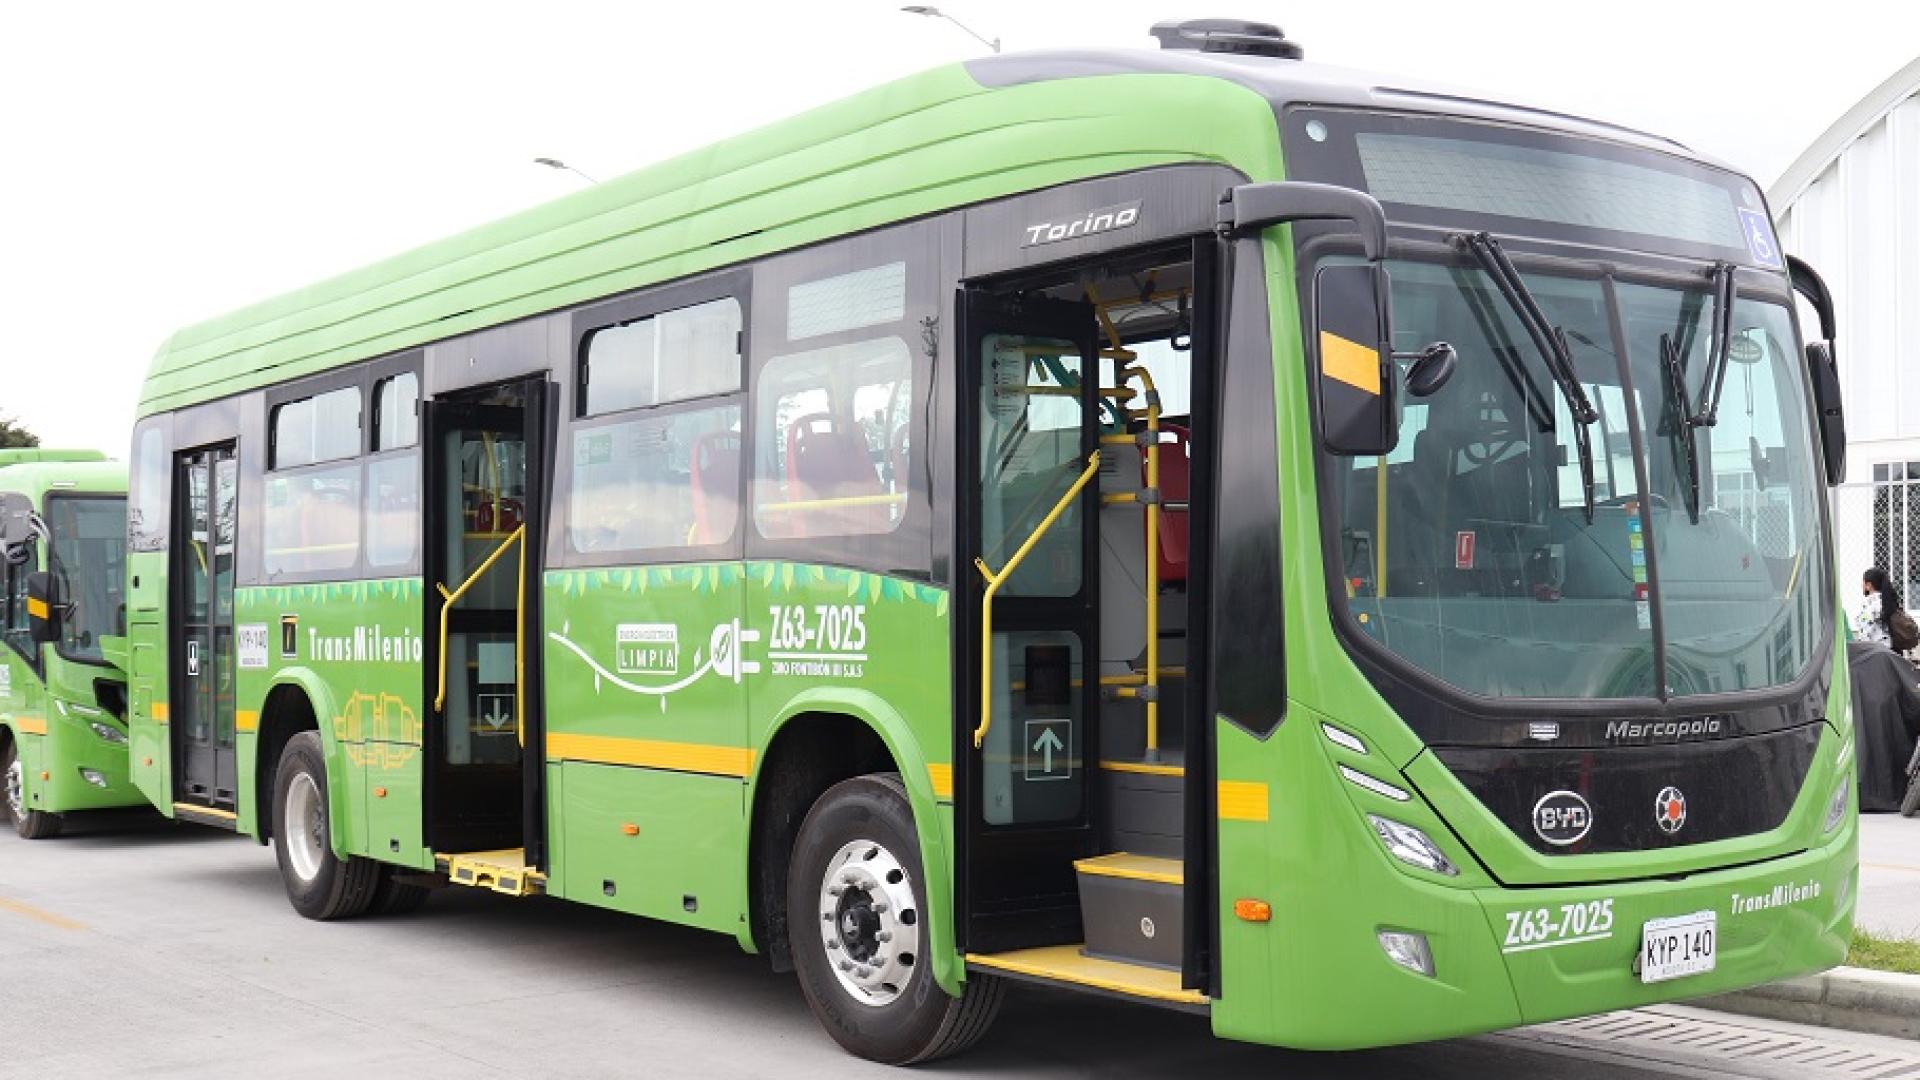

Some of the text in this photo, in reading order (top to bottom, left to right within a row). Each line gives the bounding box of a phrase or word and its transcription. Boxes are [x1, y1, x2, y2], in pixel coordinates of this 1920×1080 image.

[1027, 208, 1136, 244] Torino
[308, 624, 422, 662] TransMilenio
[769, 604, 866, 650] Z63-7025
[621, 649, 675, 668] LIMPIA
[1605, 716, 1721, 739] Marcopolo
[1541, 806, 1585, 832] BYD
[1731, 879, 1822, 916] TransMilenio
[1505, 898, 1615, 946] Z63-7025
[1647, 929, 1712, 967] KYP 140
